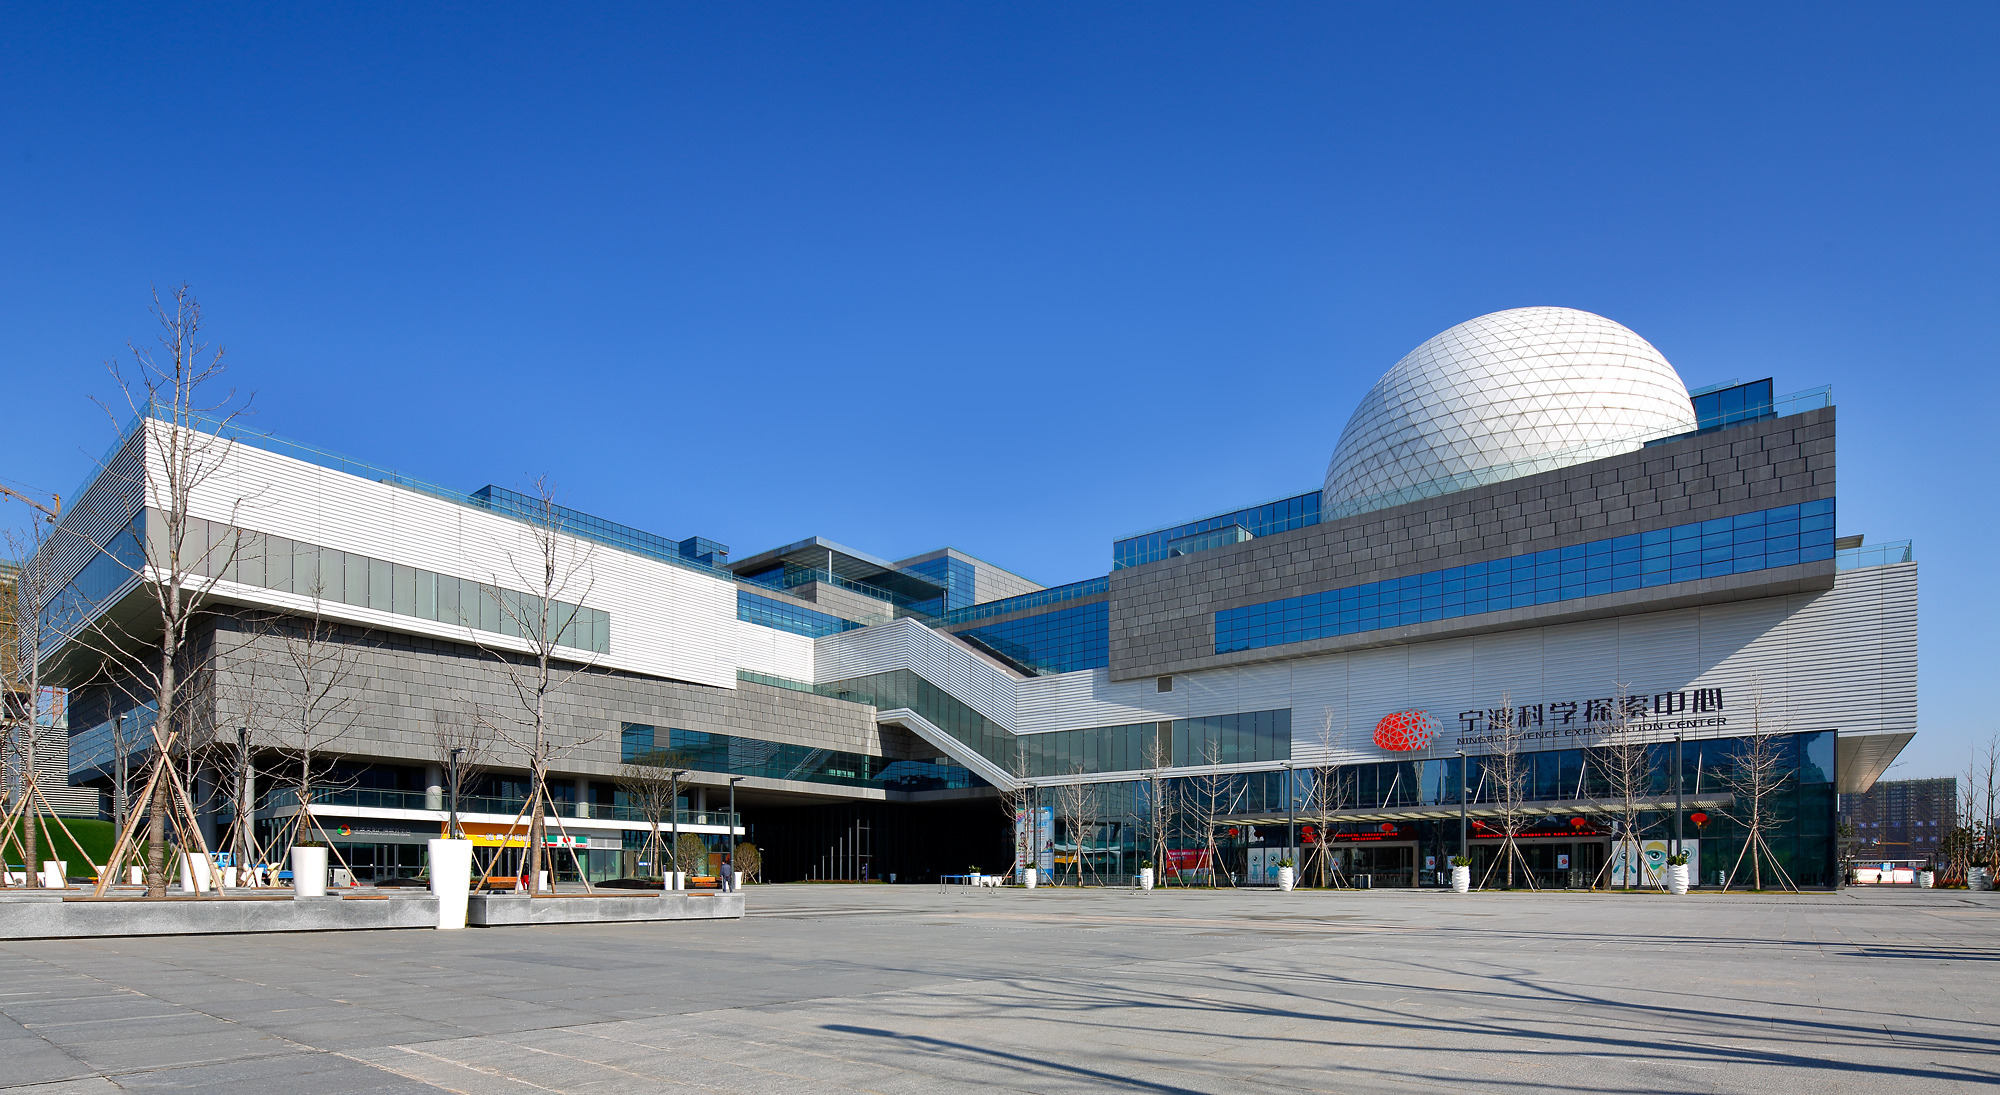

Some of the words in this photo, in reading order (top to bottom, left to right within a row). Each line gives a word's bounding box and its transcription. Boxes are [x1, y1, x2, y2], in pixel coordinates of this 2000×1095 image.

[1458, 688, 1723, 732] 宁波科学探索中心
[1457, 734, 1503, 745] NINGBO
[1565, 723, 1662, 737] EXPLORATION
[1668, 718, 1727, 729] CENTER
